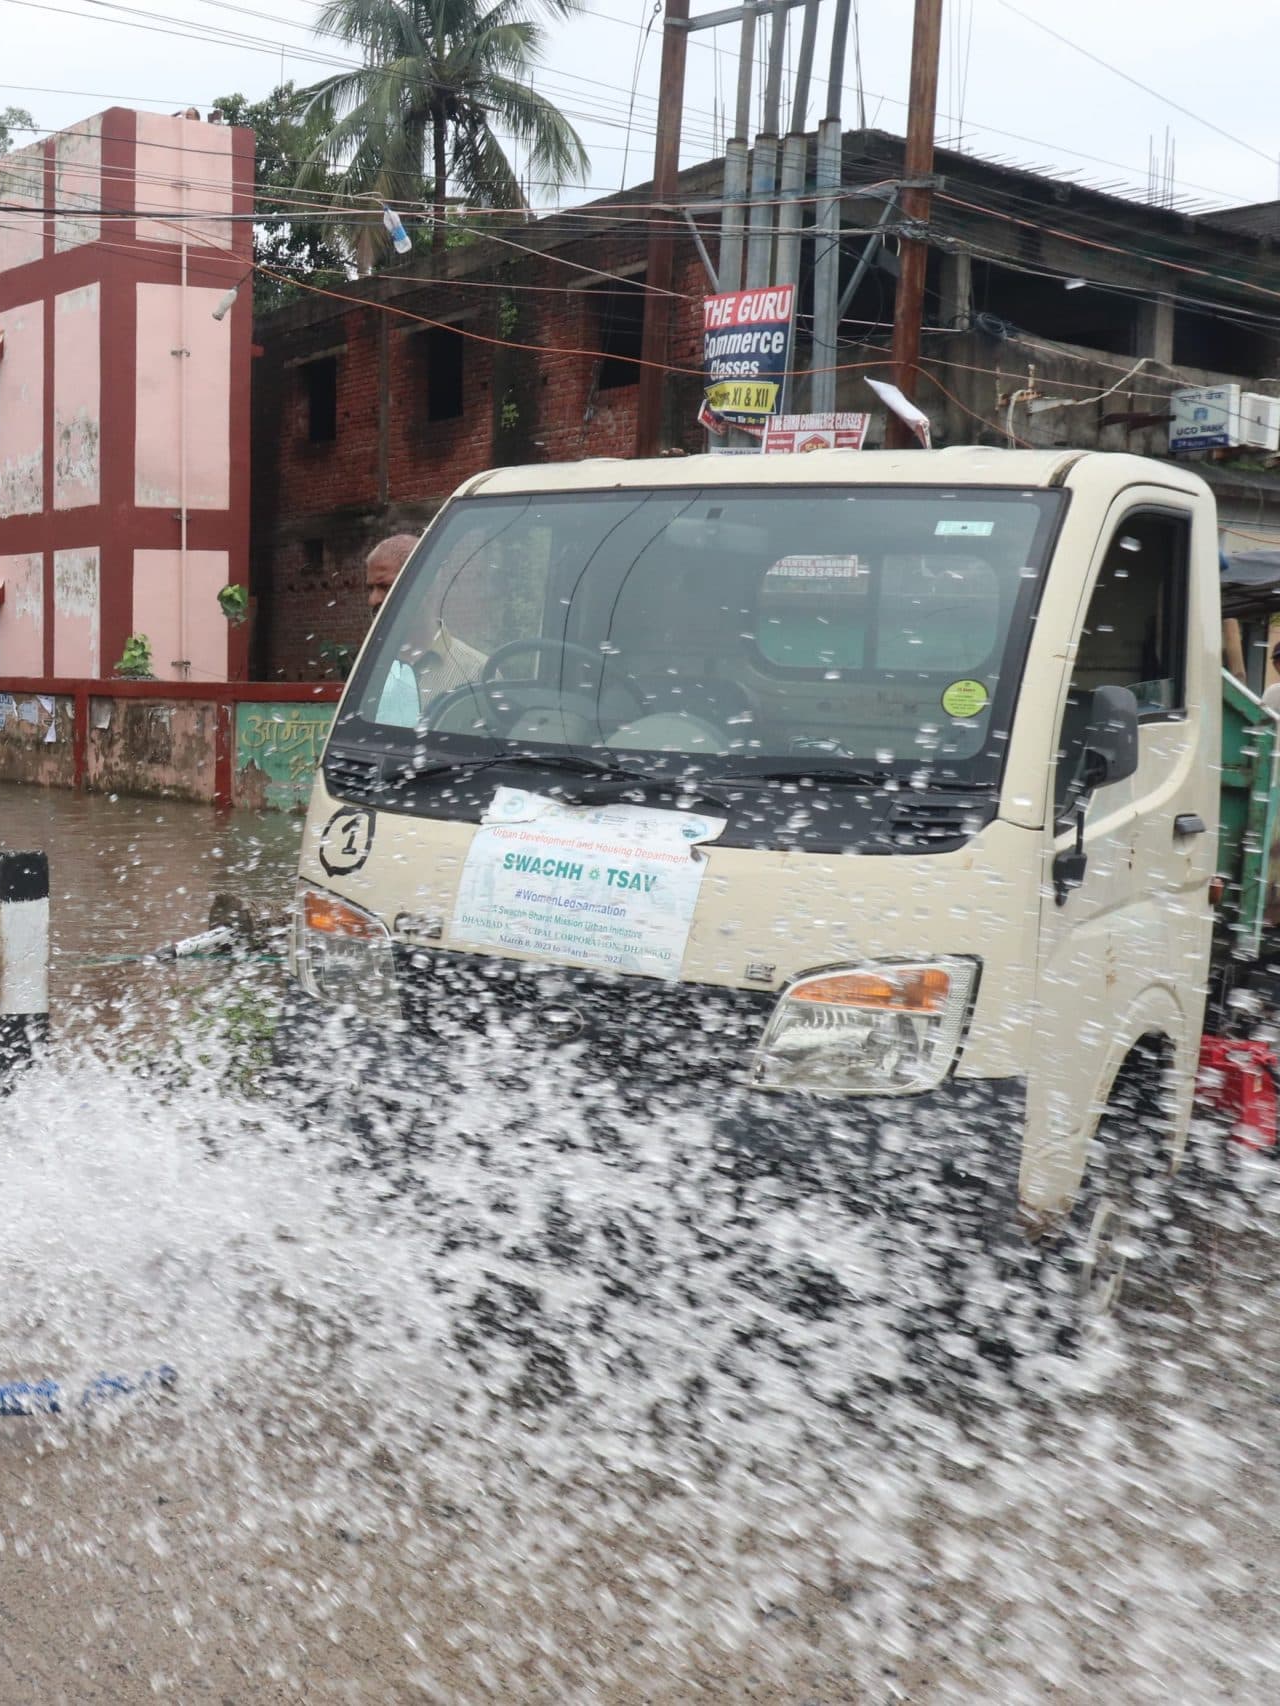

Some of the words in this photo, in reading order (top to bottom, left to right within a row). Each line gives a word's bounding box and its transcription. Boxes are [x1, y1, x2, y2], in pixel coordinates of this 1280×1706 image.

[704, 297, 736, 329] THE
[738, 290, 791, 322] GURU
[705, 331, 784, 361] Commerce
[710, 359, 760, 381] Classes
[731, 387, 742, 406] XI
[755, 388, 769, 408] XII
[835, 412, 863, 430] CLASSES
[1176, 426, 1198, 436] UCO
[1200, 424, 1224, 433] BANK
[493, 828, 518, 840] Urban
[519, 832, 575, 848] Development
[577, 839, 593, 851] and
[596, 842, 633, 858] Housing
[634, 847, 689, 865] Department
[503, 852, 584, 881] SWACHH
[607, 868, 658, 893] TSAV
[584, 920, 608, 933] Urban
[553, 943, 561, 953] to
